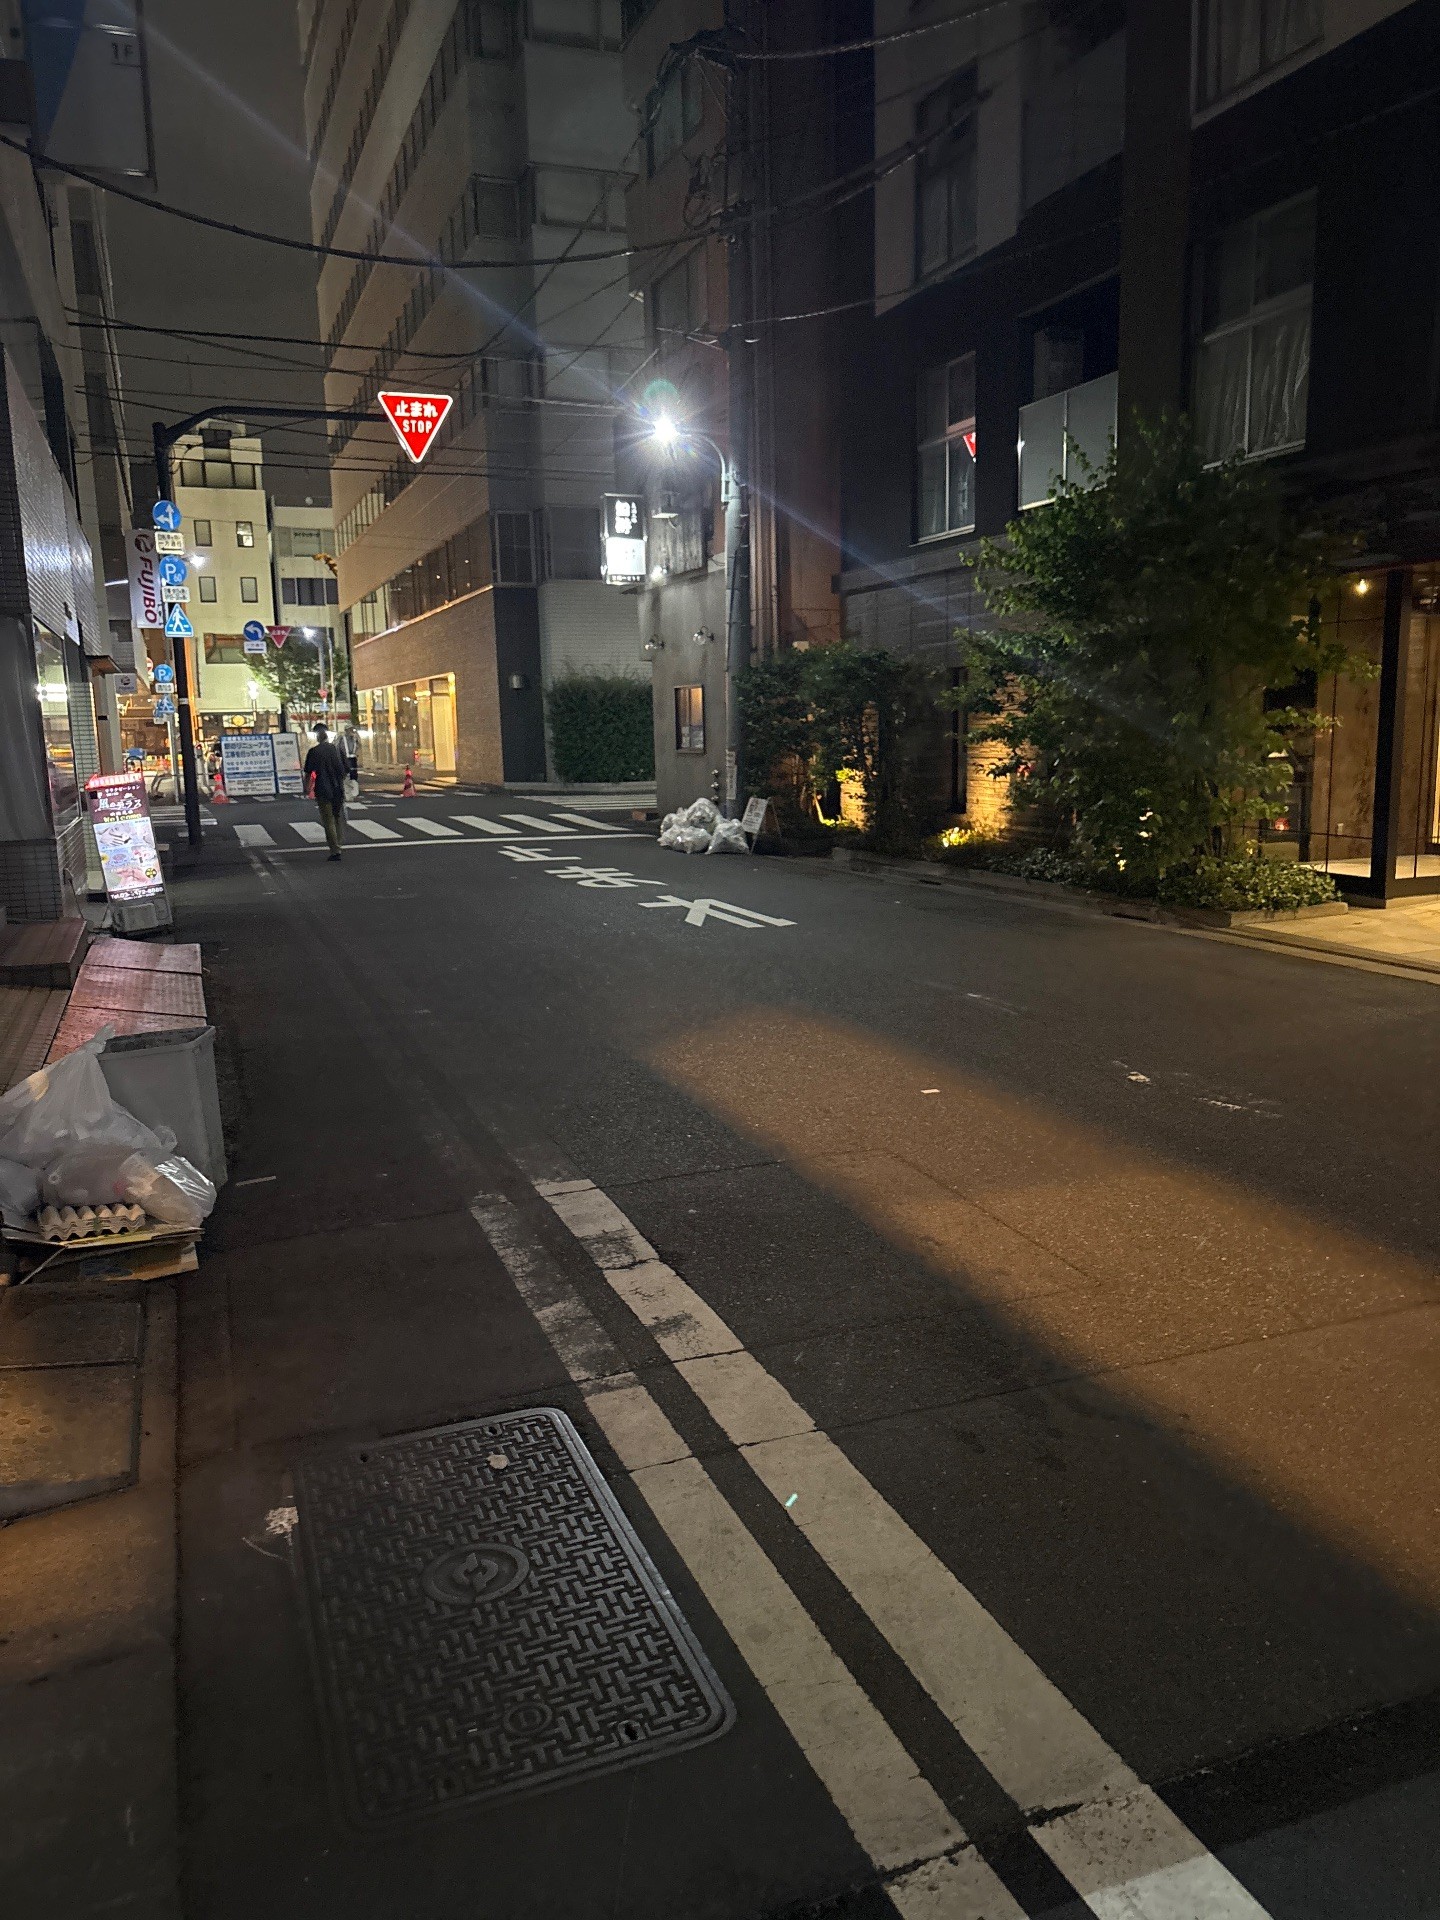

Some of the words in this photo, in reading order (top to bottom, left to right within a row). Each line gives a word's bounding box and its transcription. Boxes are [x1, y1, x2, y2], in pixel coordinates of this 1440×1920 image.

[395, 400, 438, 418] 止まれ
[402, 419, 432, 434] STOP
[165, 563, 176, 583] P
[138, 556, 158, 624] FUJIBO
